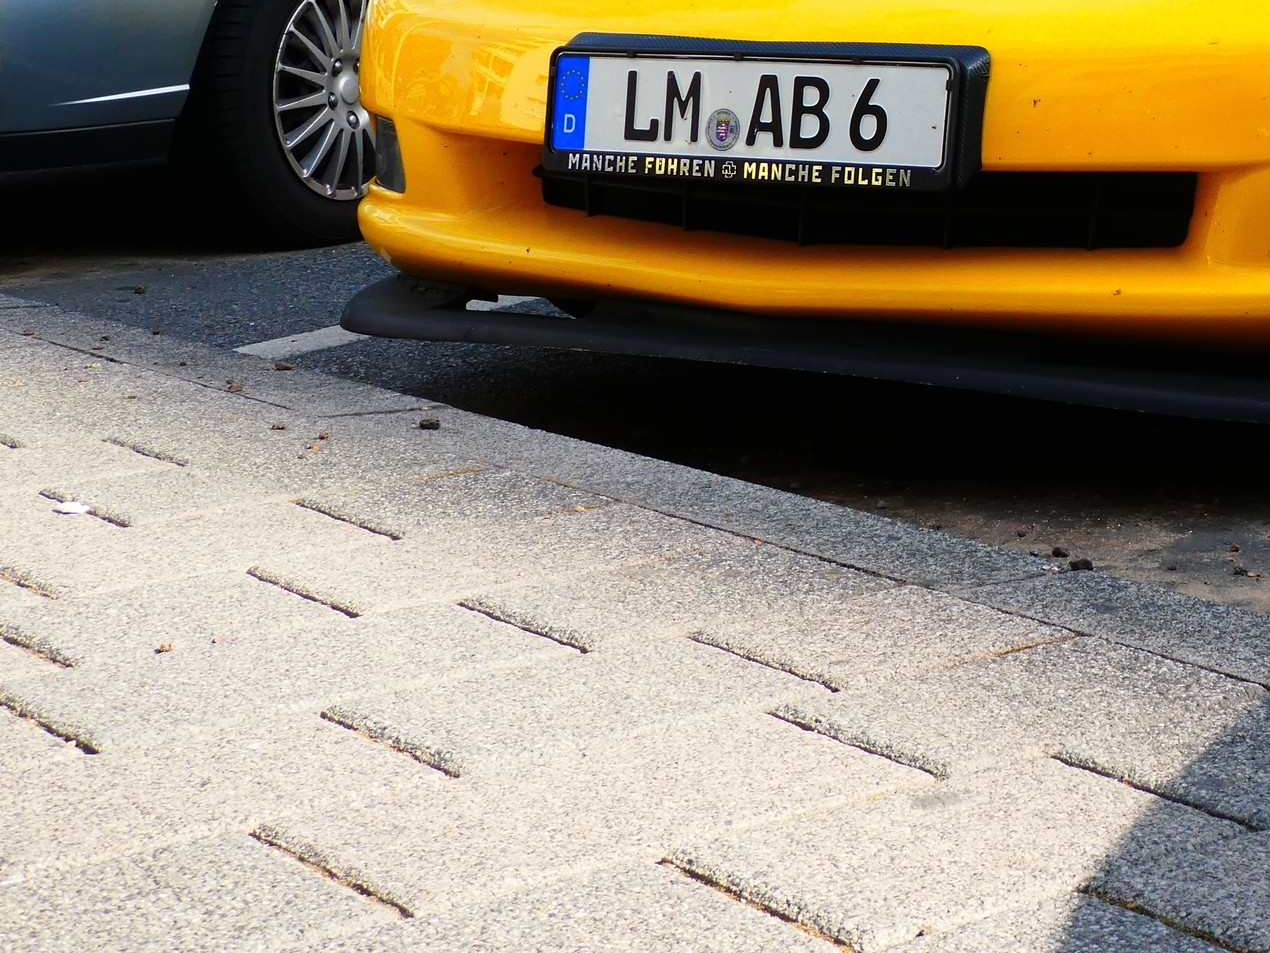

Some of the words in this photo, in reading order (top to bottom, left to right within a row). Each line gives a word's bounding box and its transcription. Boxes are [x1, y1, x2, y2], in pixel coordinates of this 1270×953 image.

[563, 114, 576, 134] D
[624, 69, 702, 143] LM
[745, 73, 831, 150] AB
[849, 77, 888, 152] 6
[568, 153, 637, 174] MANCHE
[645, 156, 715, 177] FÜHREN
[743, 162, 823, 183] MANCHE
[831, 165, 911, 187] FOLGEN
